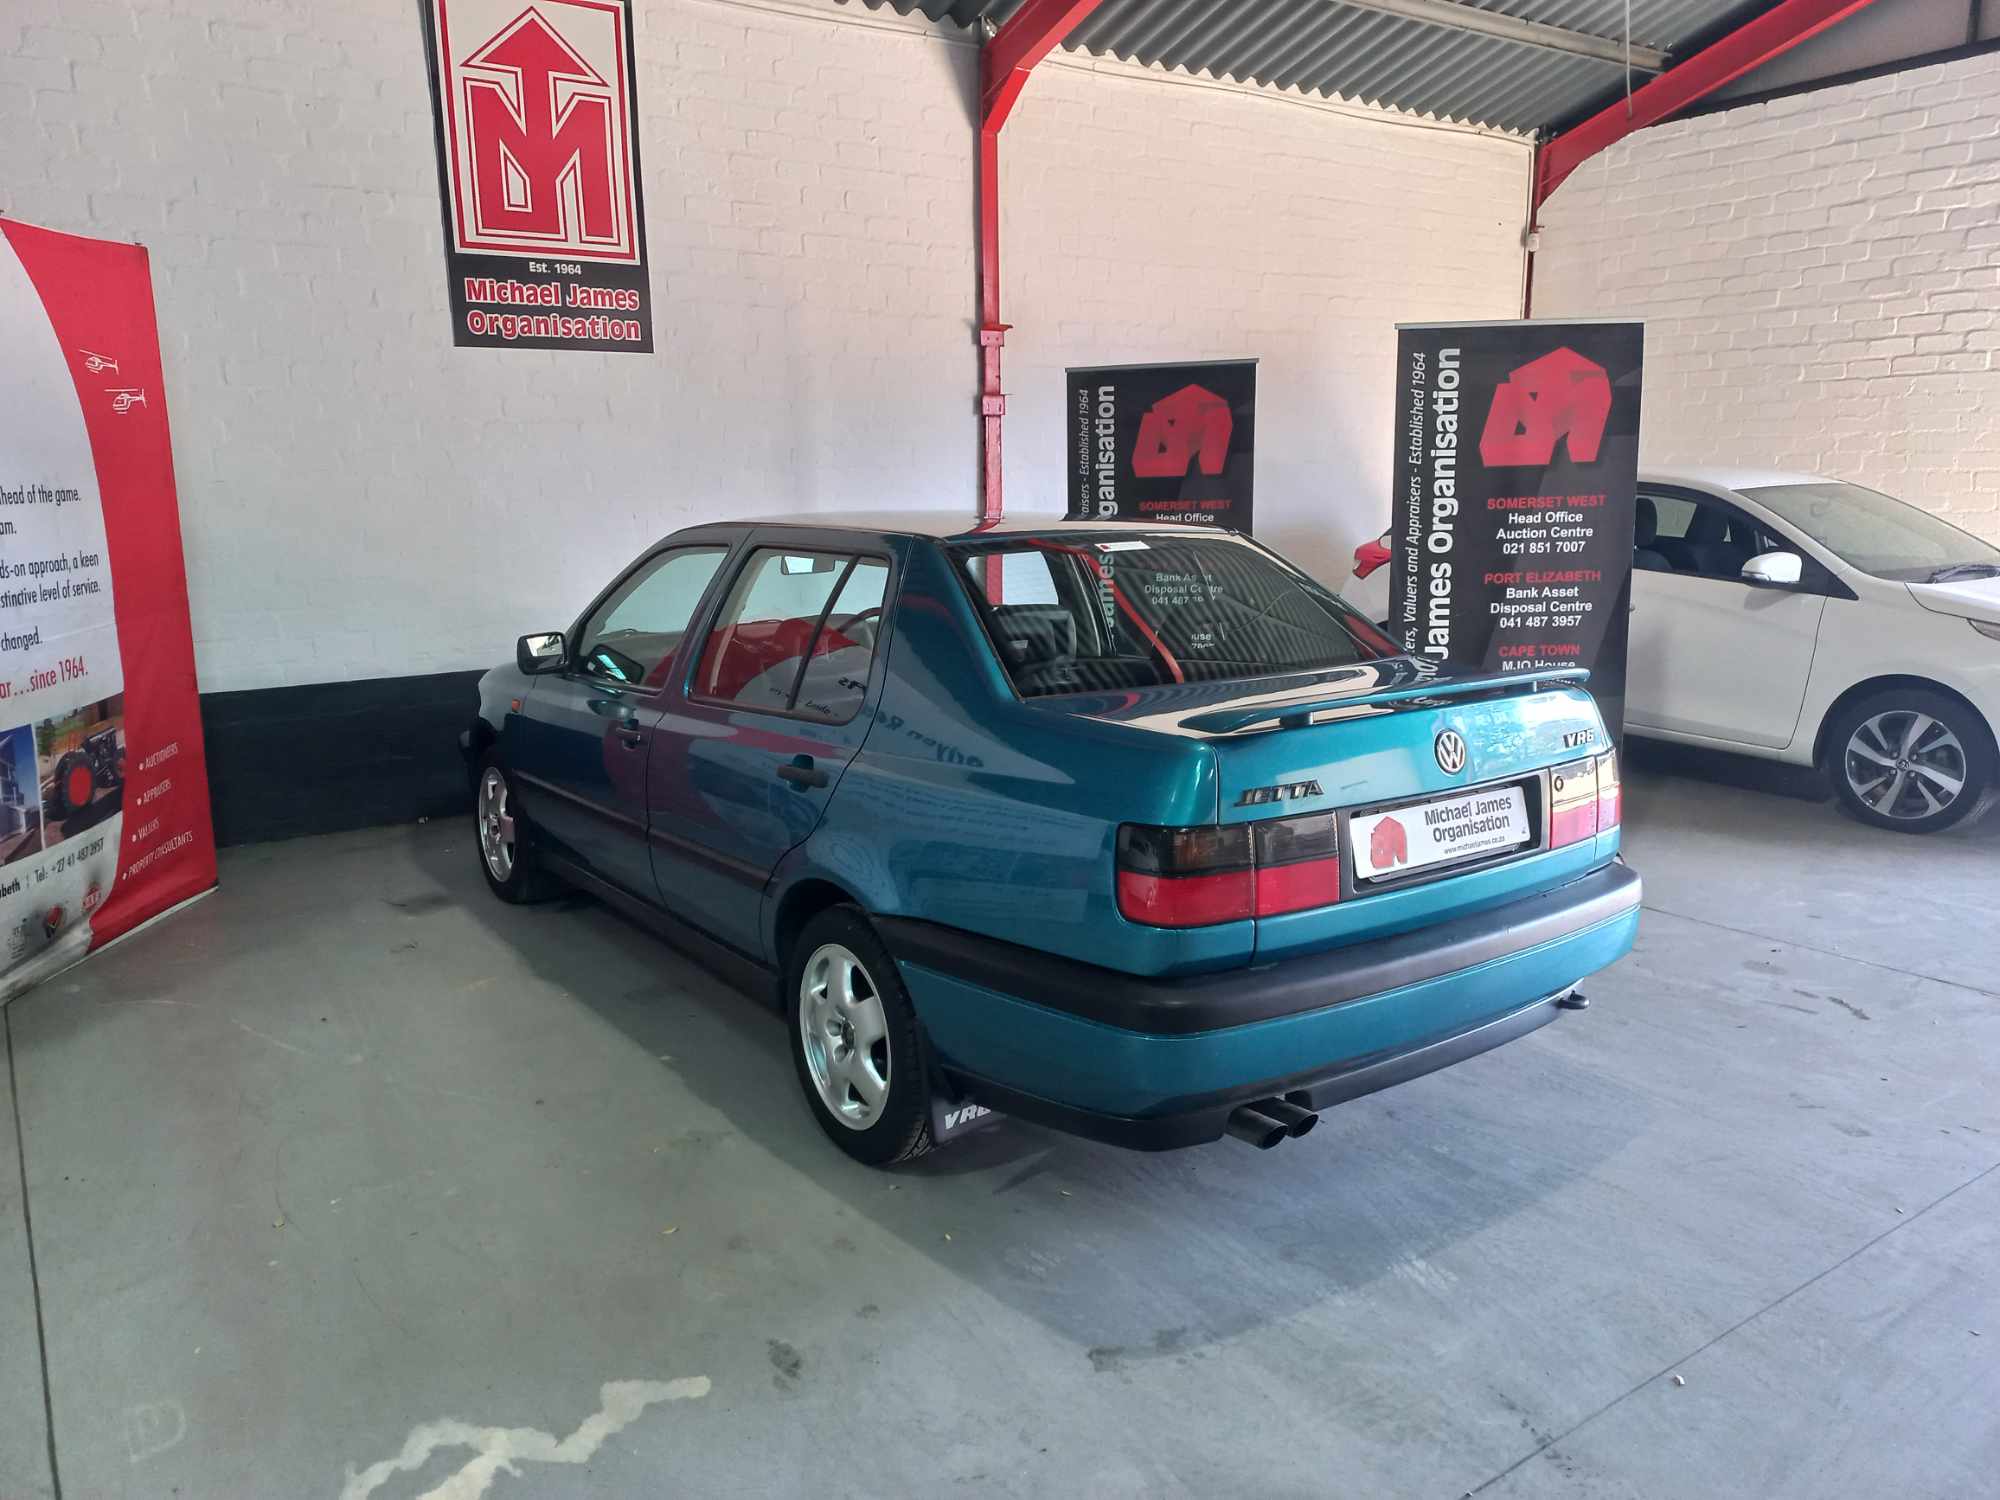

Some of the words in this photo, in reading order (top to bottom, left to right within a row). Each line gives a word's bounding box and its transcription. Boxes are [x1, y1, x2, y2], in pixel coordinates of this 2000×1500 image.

[529, 262, 551, 273] Est.
[554, 263, 582, 275] 1964
[464, 277, 561, 306] Michael
[566, 284, 640, 310] James
[467, 310, 641, 340] Organisation
[1412, 352, 1426, 385] 1964
[1079, 389, 1089, 414] 1964
[1409, 389, 1425, 465] Established
[1079, 417, 1090, 475] Established
[1095, 385, 1118, 517] ganisation
[1427, 348, 1461, 554] Organisation
[0, 485, 24, 505] head
[27, 484, 36, 504] of
[38, 484, 53, 503] the
[55, 488, 81, 506] game.
[1487, 496, 1564, 510] SOMERSET
[1567, 495, 1606, 507] WEST
[1156, 513, 1182, 521] Head
[1184, 512, 1214, 522] Office
[1406, 476, 1422, 545] Appraisers
[1508, 511, 1541, 524] Head
[1545, 511, 1583, 523] Office
[1496, 528, 1547, 540] Auction
[1550, 526, 1594, 538] Centre
[1405, 547, 1419, 572] and
[1503, 542, 1525, 554] 021
[1529, 542, 1551, 553] 851
[1555, 541, 1586, 553] 7007
[28, 553, 71, 579] approach,
[73, 557, 79, 569] a
[80, 550, 99, 569] keen
[1484, 572, 1521, 584] PORT
[1525, 570, 1601, 583] ELIZABETH
[39, 580, 60, 602] level
[62, 579, 71, 599] of
[72, 578, 101, 597] service.
[1144, 584, 1187, 595] Disposal
[1156, 573, 1181, 582] Bank
[1403, 576, 1418, 623] Valuers
[1506, 587, 1539, 599] Bank
[1541, 586, 1579, 598] Asset
[1424, 562, 1452, 660] James
[1490, 601, 1546, 615] Disposal
[1550, 601, 1593, 612] Centre
[1500, 617, 1521, 628] 041
[1525, 616, 1548, 627] 487
[1552, 615, 1582, 627] 3957
[1, 625, 43, 651] changed.
[1498, 644, 1536, 657] CAPE
[1540, 644, 1580, 656] TOWN
[59, 656, 88, 682] 1964.
[1563, 728, 1594, 748] VR6
[1234, 779, 1324, 807] JETTA
[1424, 801, 1472, 826] Michael
[1475, 797, 1512, 815] James
[1433, 815, 1510, 842] Organisation
[34, 864, 48, 883] Tel:
